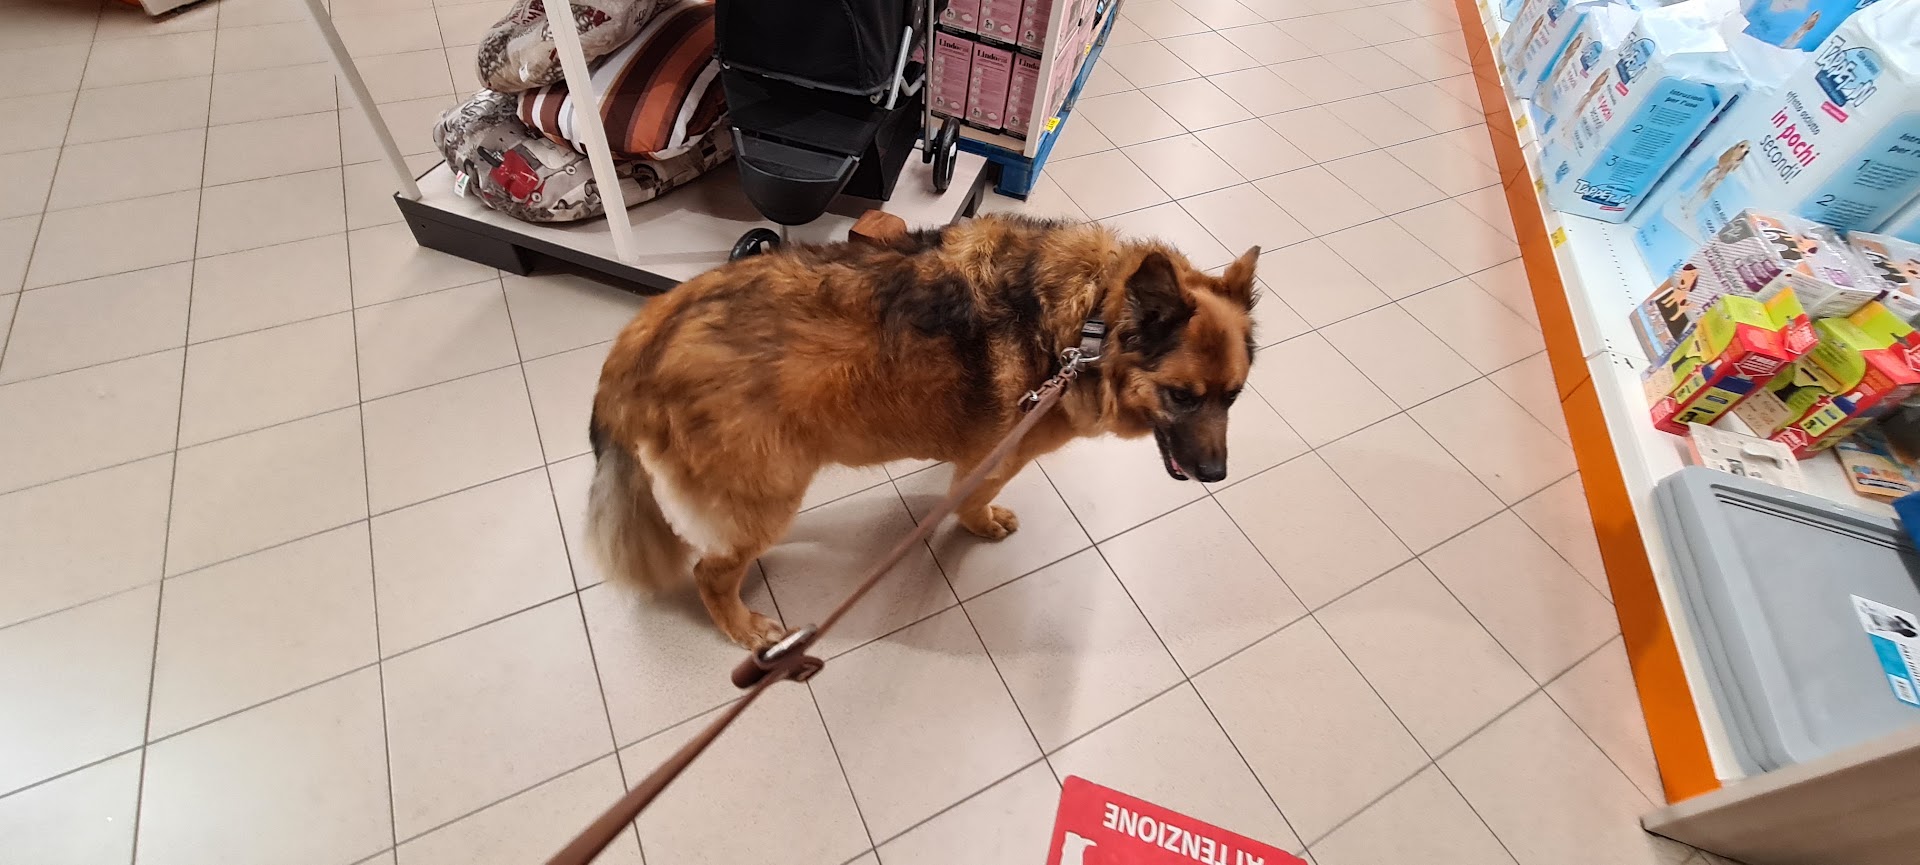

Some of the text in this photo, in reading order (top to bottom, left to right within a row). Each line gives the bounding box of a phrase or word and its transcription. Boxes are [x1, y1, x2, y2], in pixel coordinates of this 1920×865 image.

[1018, 59, 1039, 70] Lindo
[1650, 105, 1657, 113] 1
[1632, 124, 1644, 134] 2
[1770, 106, 1820, 167] in pochi
[1606, 155, 1619, 167] 3
[1760, 135, 1802, 184] secondi!
[1858, 160, 1871, 170] 1
[1816, 194, 1836, 206] 2
